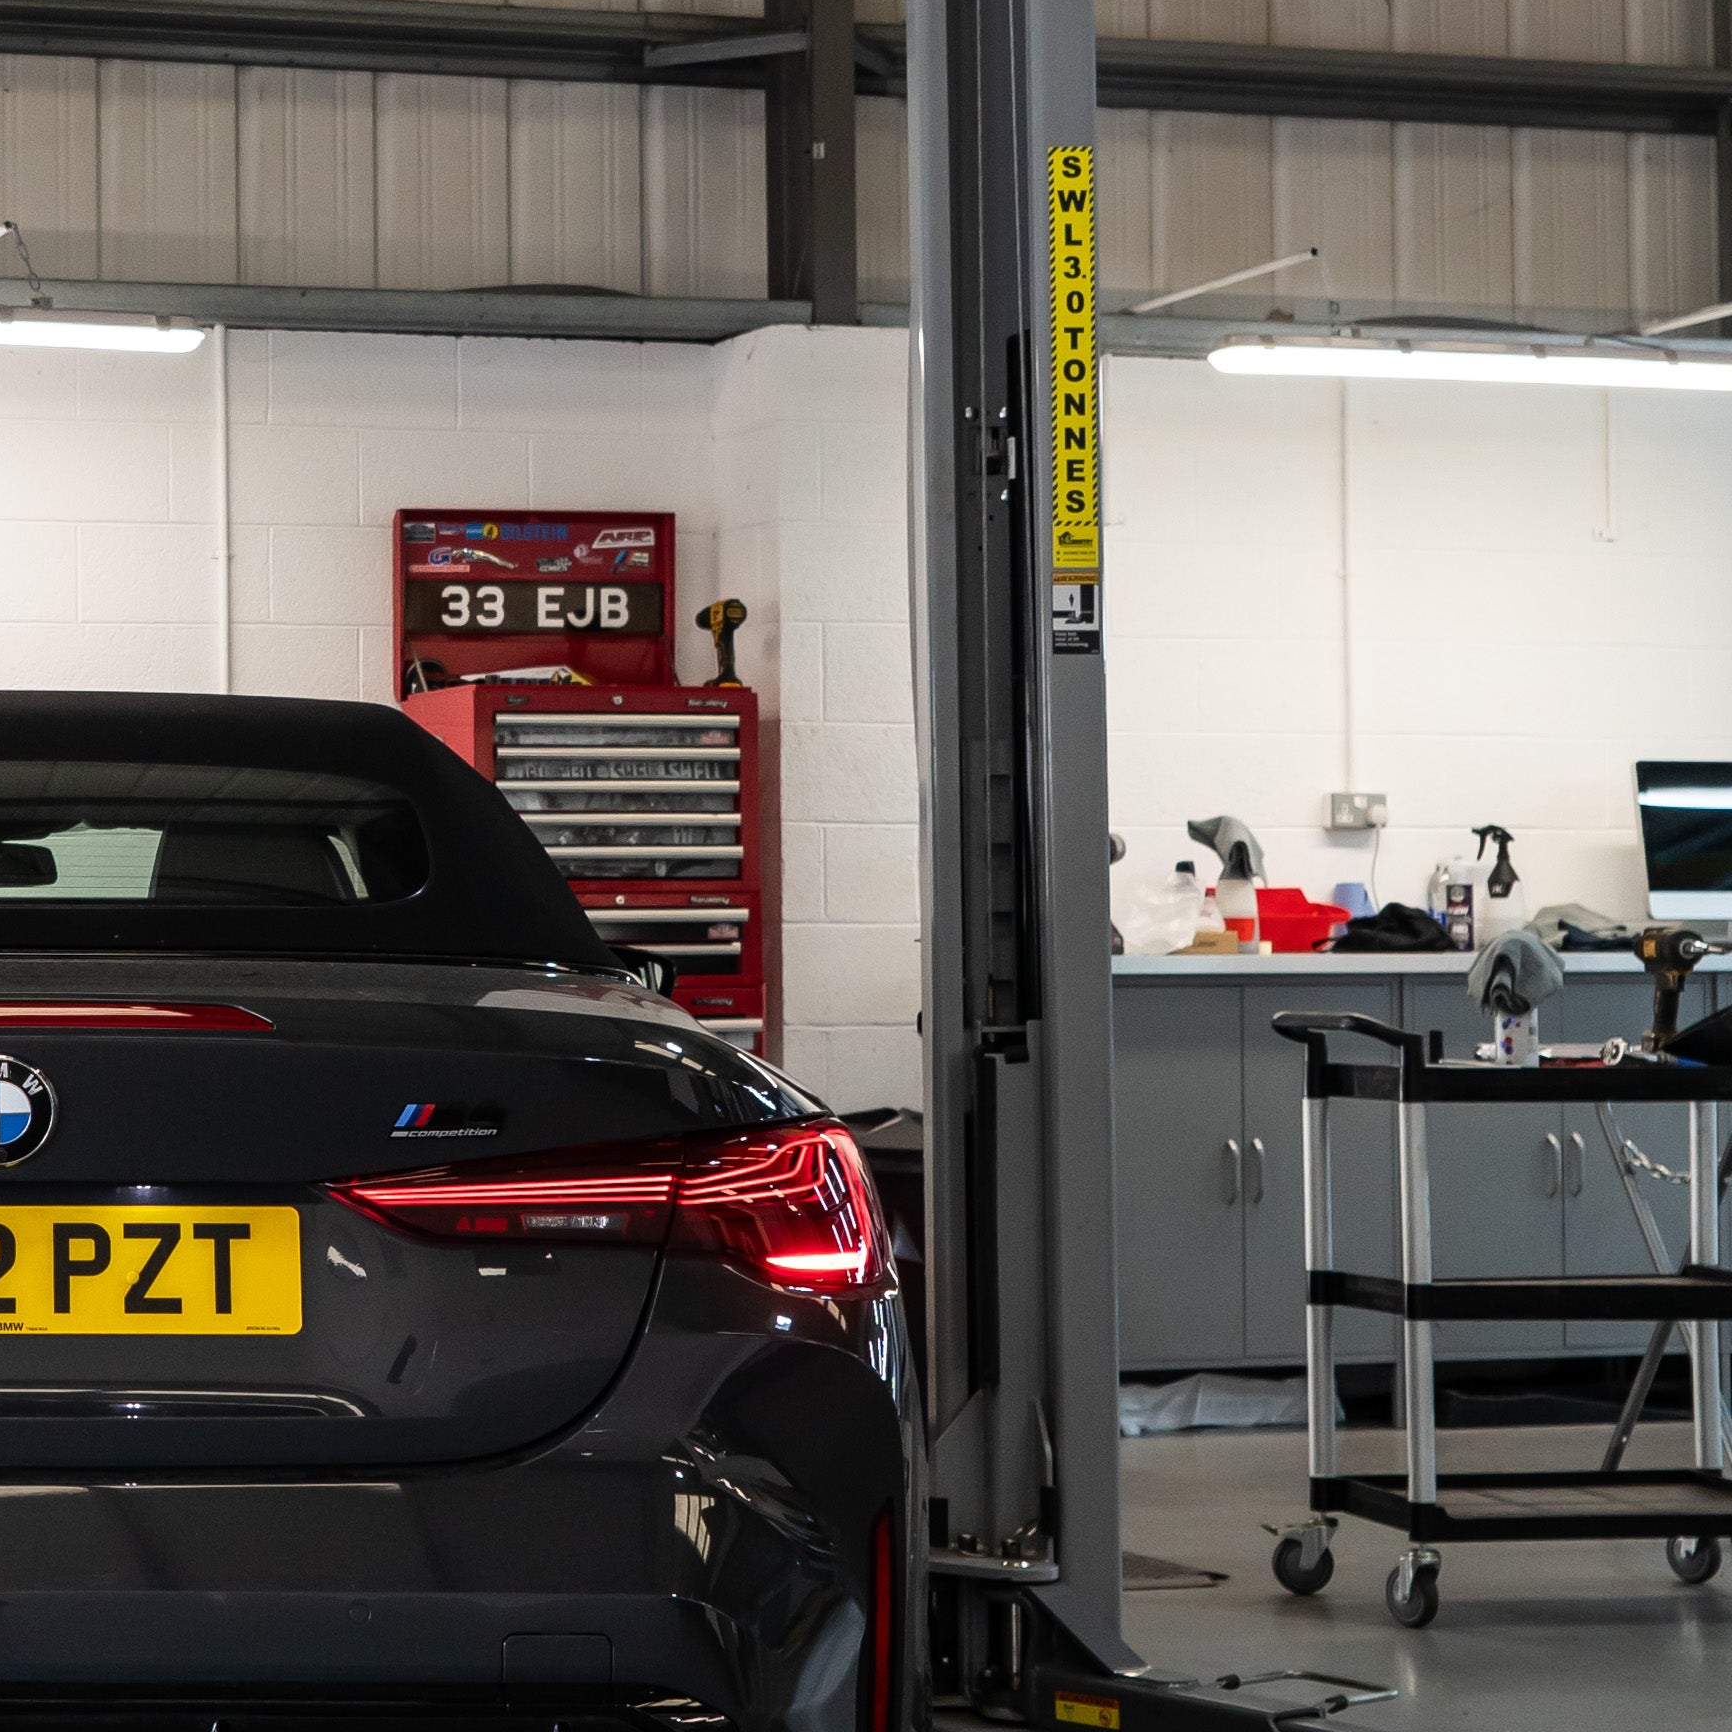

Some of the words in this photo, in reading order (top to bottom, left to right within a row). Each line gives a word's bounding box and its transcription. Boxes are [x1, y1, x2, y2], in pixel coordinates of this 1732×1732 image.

[440, 585, 505, 627] 33
[537, 586, 630, 629] EJB
[408, 1127, 498, 1138] competition
[52, 1223, 251, 1315] PZT
